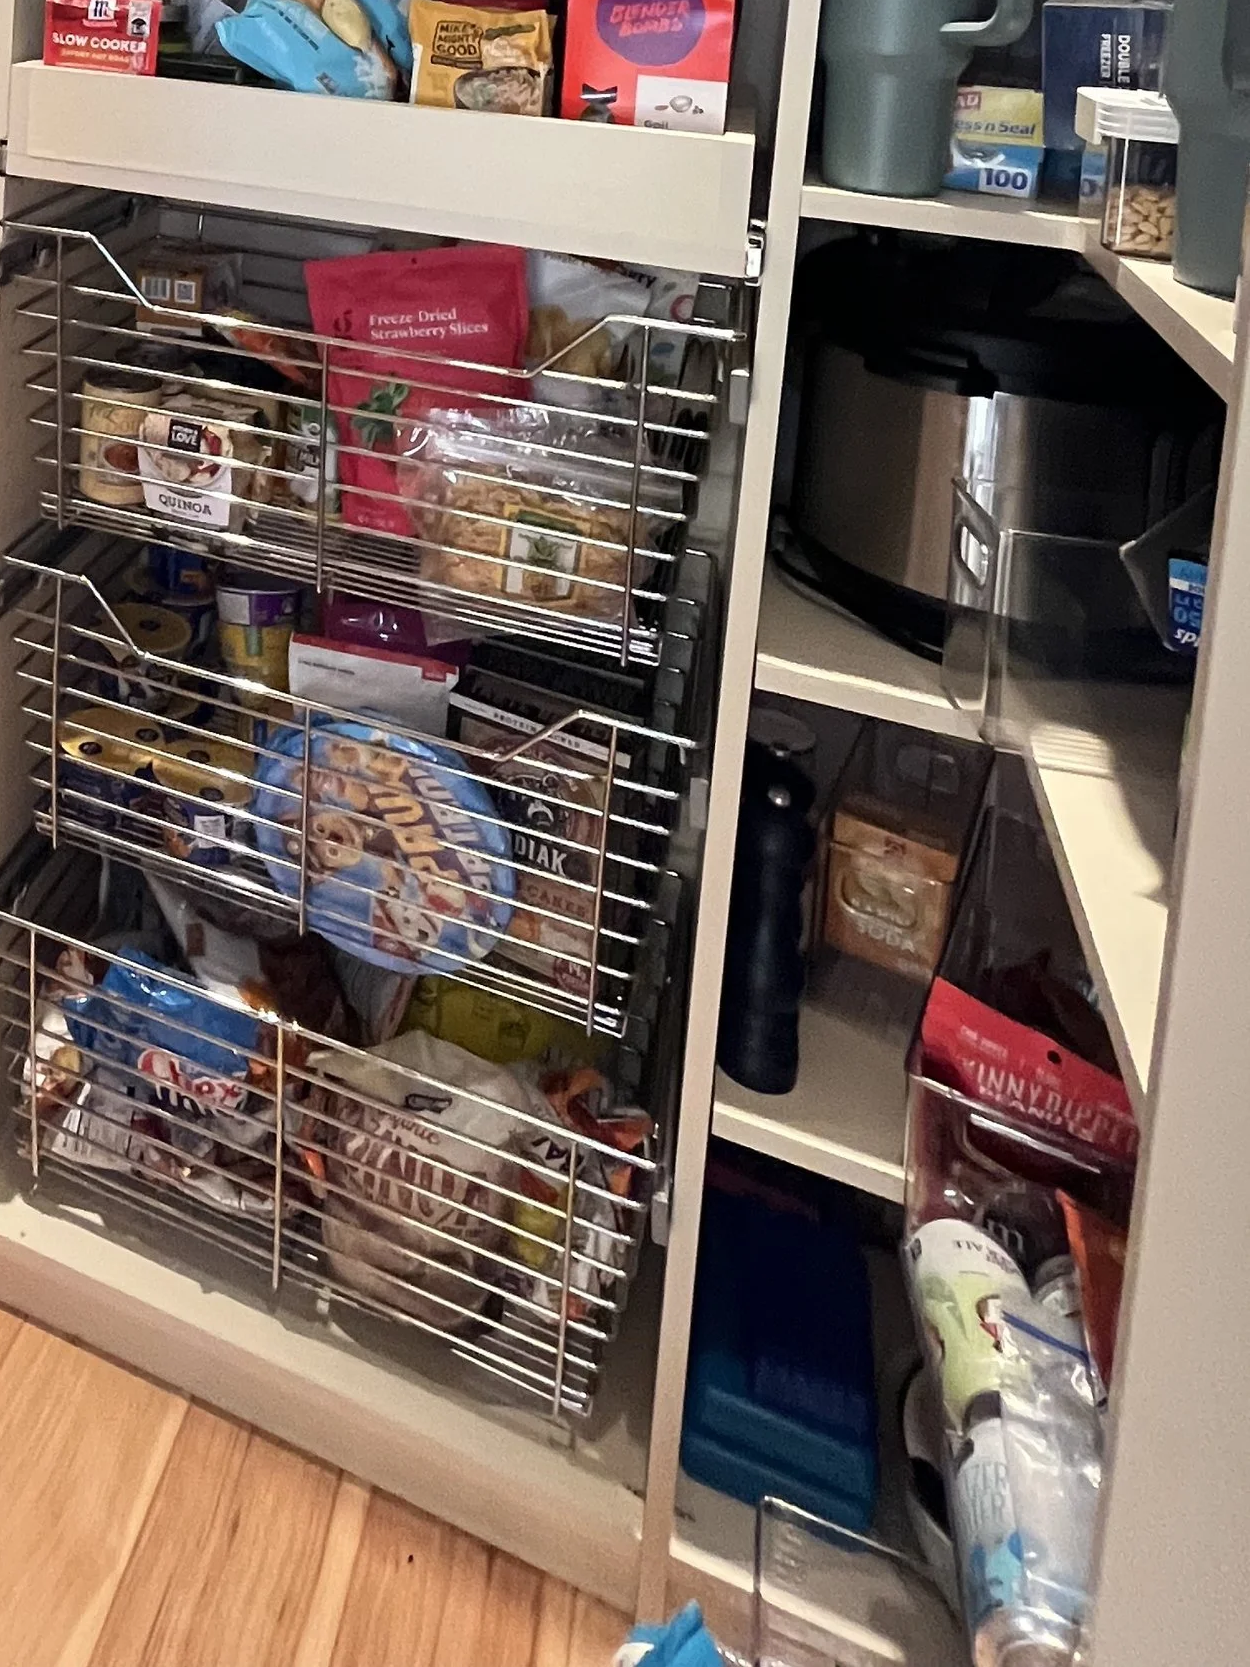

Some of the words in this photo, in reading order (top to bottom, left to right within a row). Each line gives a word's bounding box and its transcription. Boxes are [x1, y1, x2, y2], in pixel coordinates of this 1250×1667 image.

[610, 0, 691, 24] BLENDER
[618, 17, 684, 37] BOMBS
[52, 31, 89, 47] SLOW
[91, 36, 147, 53] COOKER
[436, 44, 477, 56] GOOD
[1100, 33, 1112, 79] FREEZER
[1118, 34, 1131, 84] DOUBLE
[957, 95, 980, 109] AD
[998, 121, 1036, 136] Seal
[984, 168, 1029, 191] 100
[369, 313, 413, 328] Freeze
[418, 308, 457, 323] Dried
[370, 327, 446, 341] Strawberry
[449, 322, 489, 336] Slices
[171, 431, 199, 447] LOVE
[158, 492, 213, 516] QUINOA
[515, 836, 568, 876] DIAK
[962, 1056, 1143, 1155] INNYDIPP
